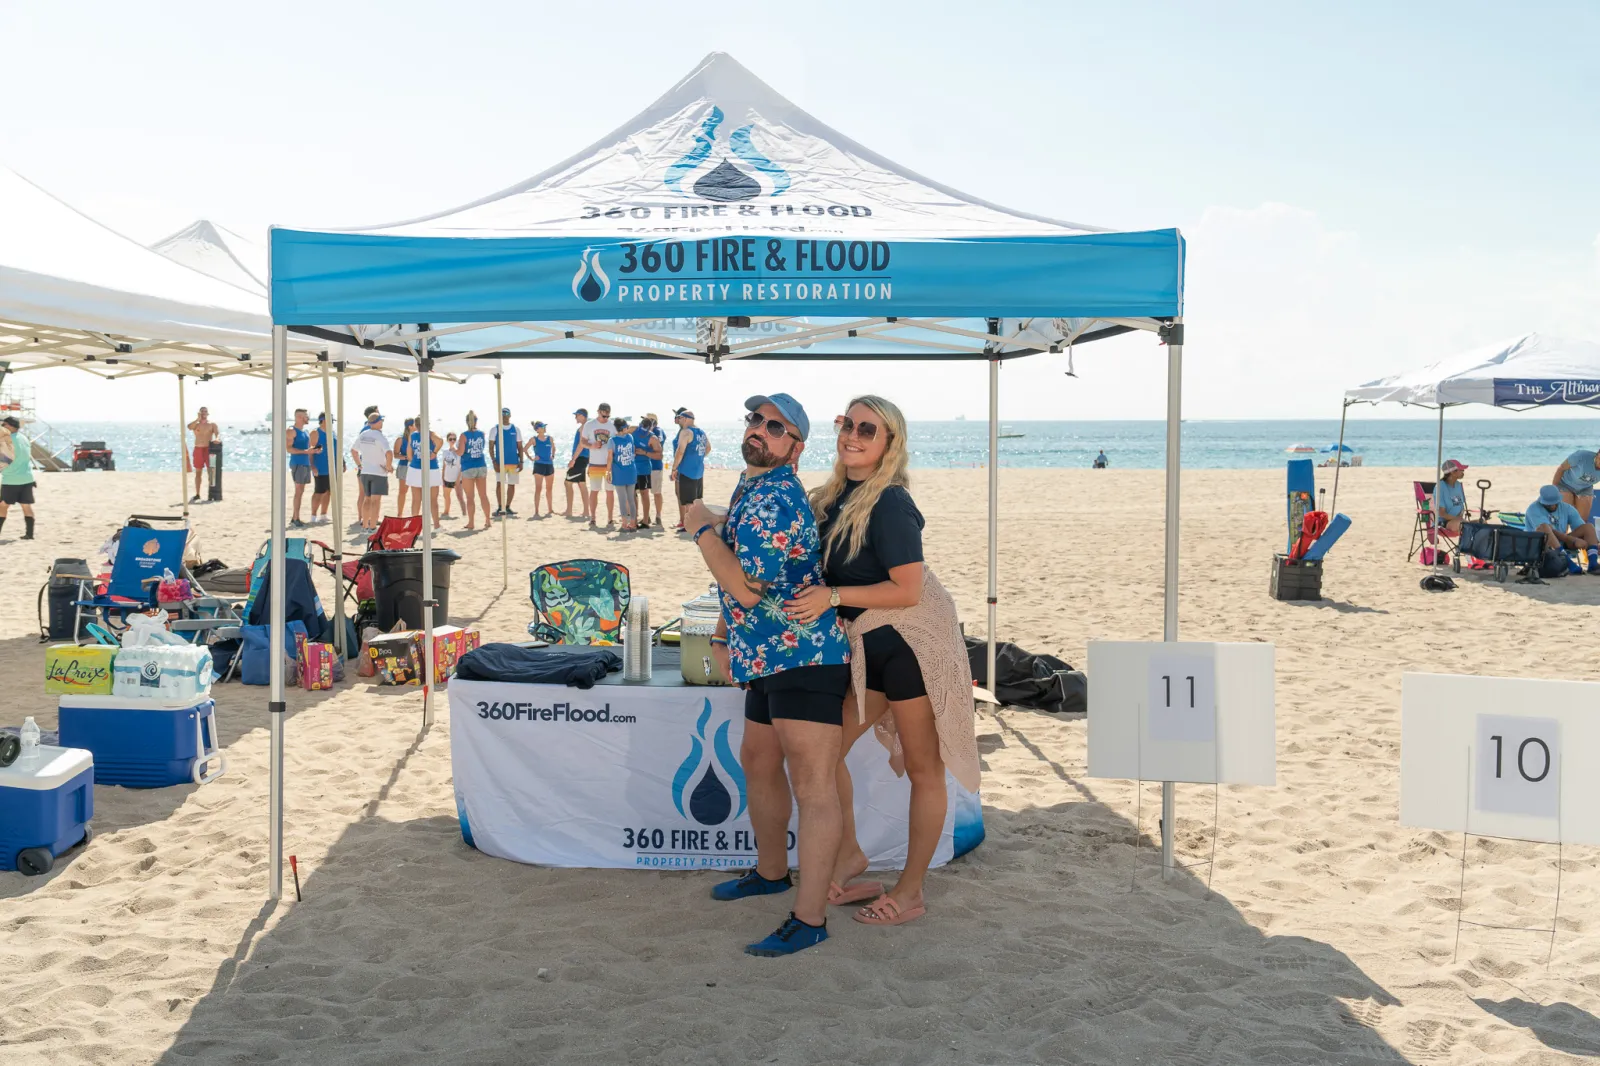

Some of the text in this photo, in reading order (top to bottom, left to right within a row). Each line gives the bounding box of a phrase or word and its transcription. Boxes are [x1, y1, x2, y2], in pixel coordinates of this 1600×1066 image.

[580, 204, 872, 219] 360 FIRE & FLOOD
[618, 238, 891, 273] 360 FIRE & FLOOD
[618, 282, 892, 302] PROPERTY RESTORATION
[1514, 383, 1544, 395] THE
[46, 659, 105, 684] LaCroix
[1162, 674, 1196, 709] 11
[476, 701, 637, 723] 360FireFlood.com
[1489, 734, 1551, 783] 10
[622, 827, 796, 851] 360 FIRE & FLD
[636, 857, 695, 866] PROPERTY
